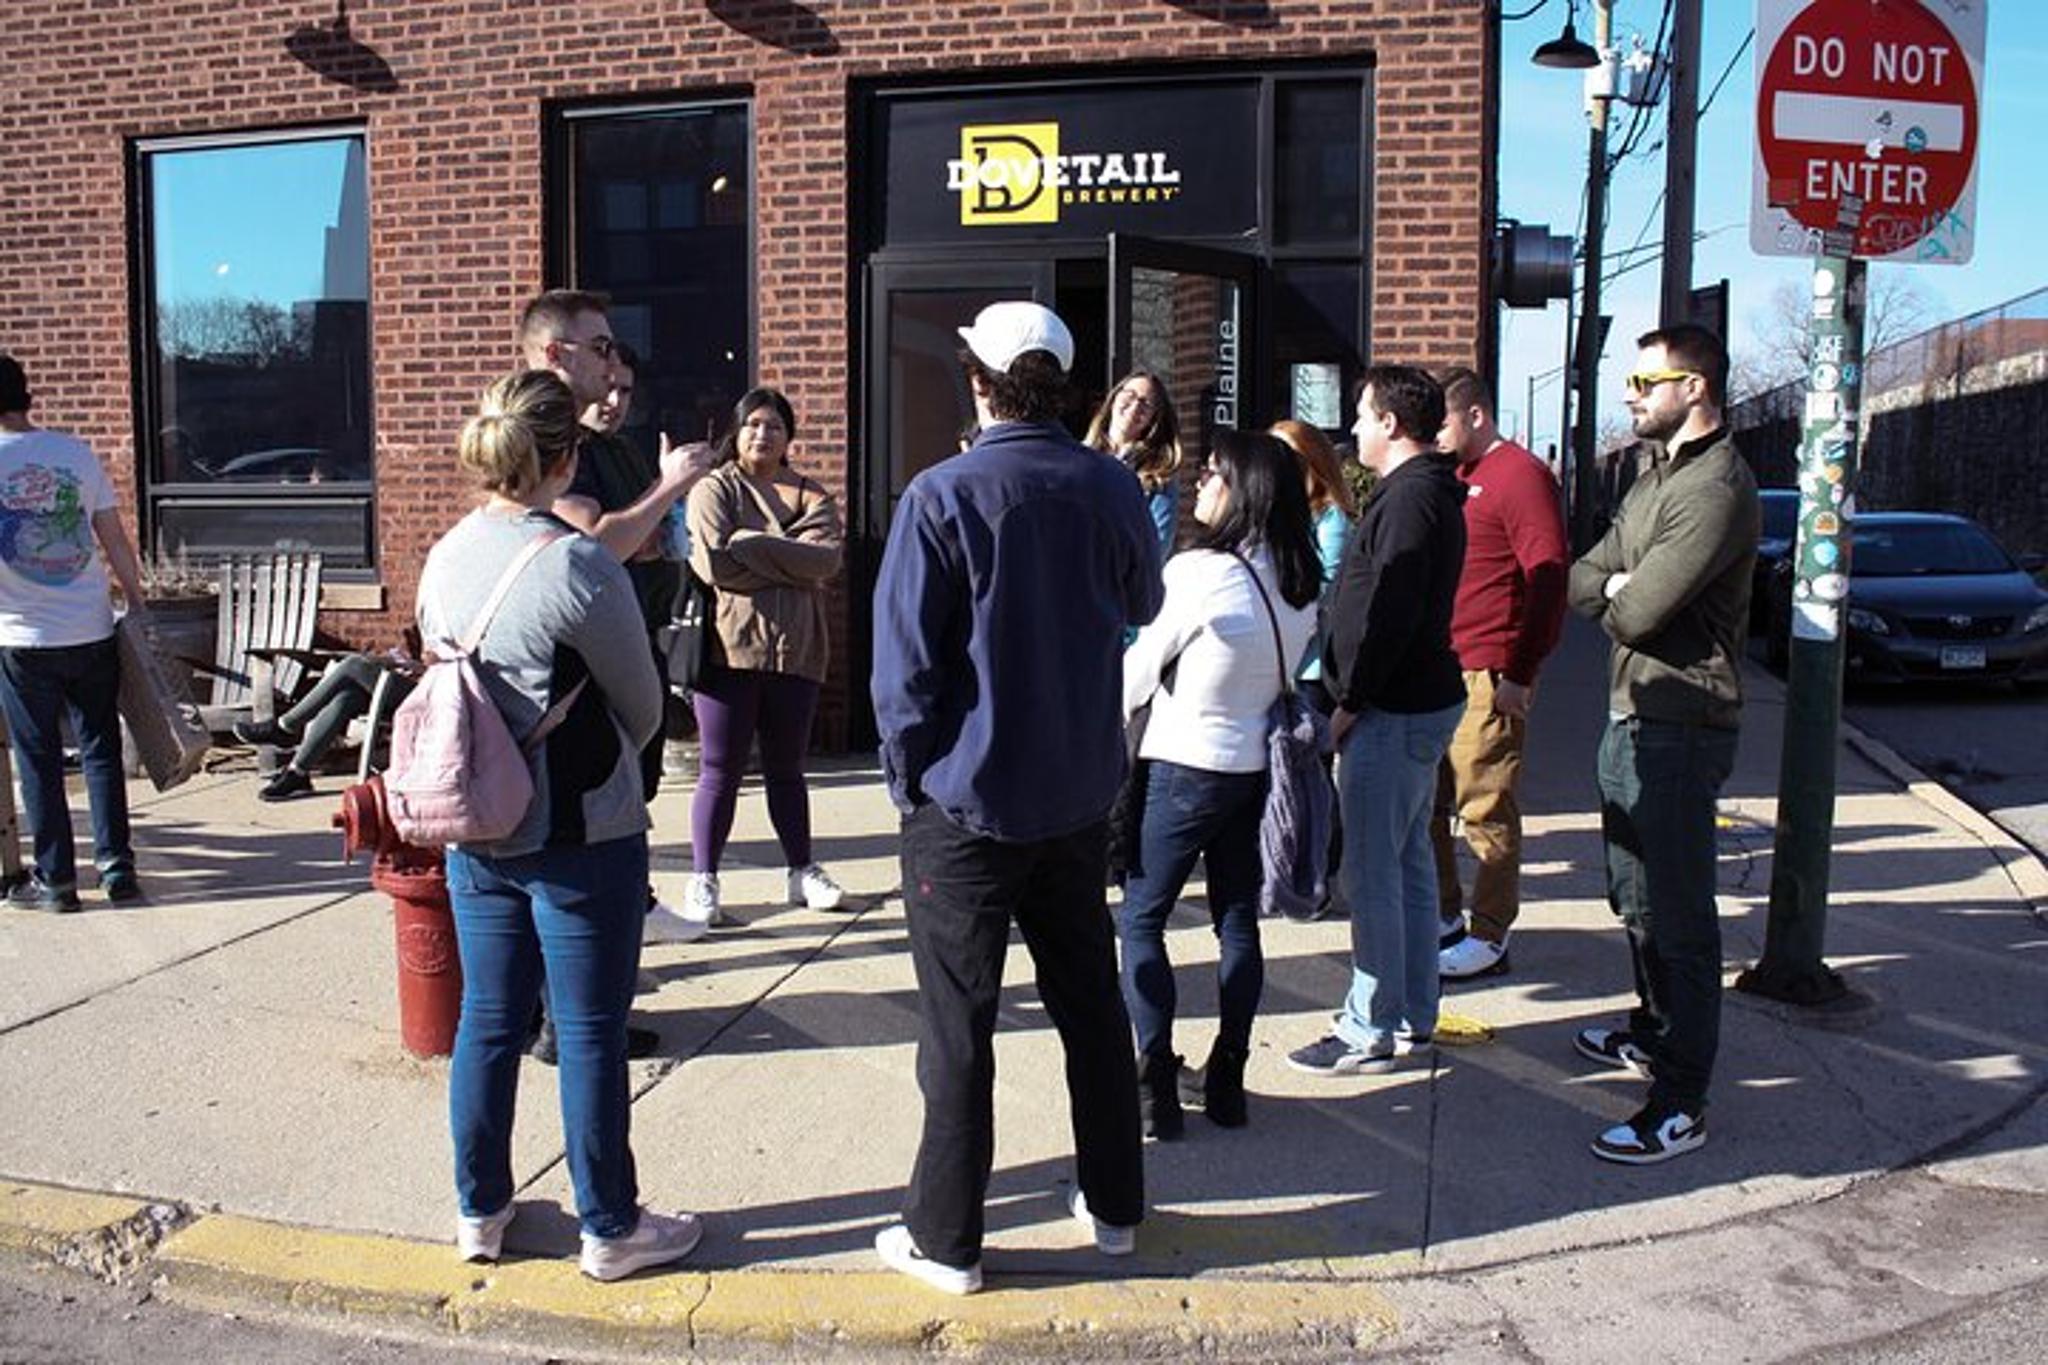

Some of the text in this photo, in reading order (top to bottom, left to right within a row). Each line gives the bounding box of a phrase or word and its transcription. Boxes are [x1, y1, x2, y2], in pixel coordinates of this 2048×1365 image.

[1794, 35, 1949, 86] DO NOT
[947, 153, 1180, 191] DOVETAIL
[1806, 159, 1928, 205] ENTER
[1063, 187, 1175, 204] BREWERY
[1214, 320, 1236, 425] Plaine
